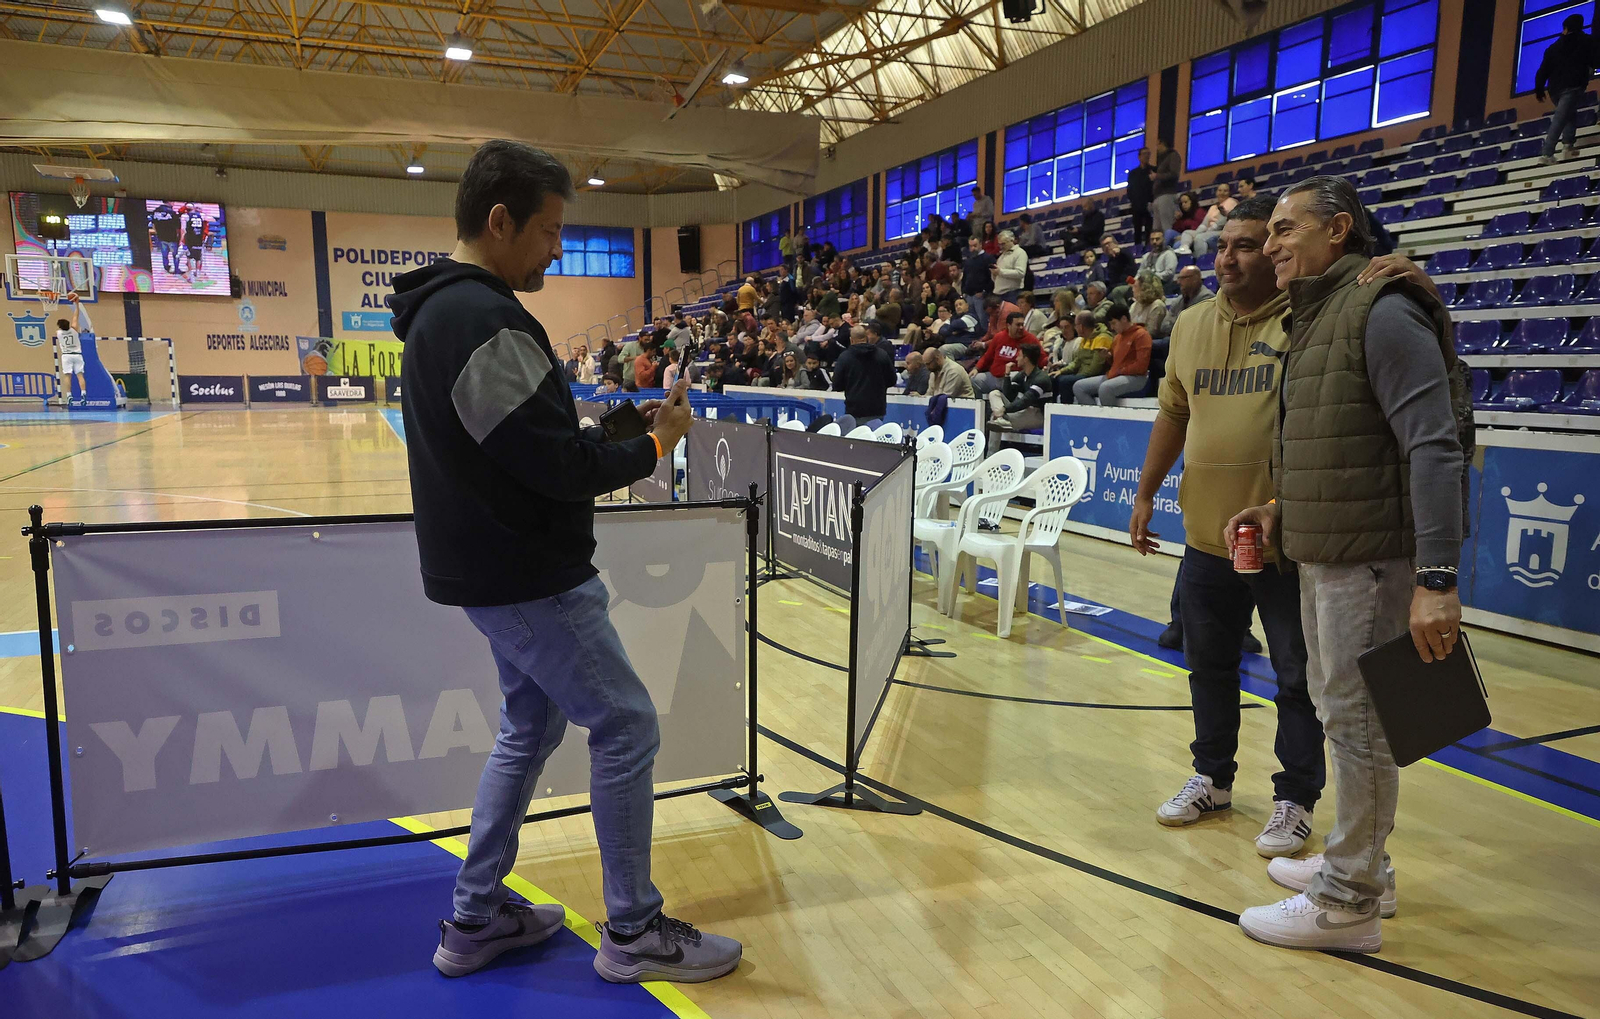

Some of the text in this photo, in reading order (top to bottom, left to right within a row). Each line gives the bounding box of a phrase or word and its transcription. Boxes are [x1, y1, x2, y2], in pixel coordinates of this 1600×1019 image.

[333, 247, 453, 266] POLIDEPOR
[361, 271, 401, 286] CIU
[247, 280, 288, 297] MUNICIPAL
[63, 335, 74, 346] 27
[206, 334, 289, 351] DEPORTES ALGECIRAS
[1193, 363, 1275, 396] PUMA
[329, 388, 363, 397] SAAVEDRA
[1103, 489, 1116, 503] de
[780, 467, 866, 543] LAPITAN
